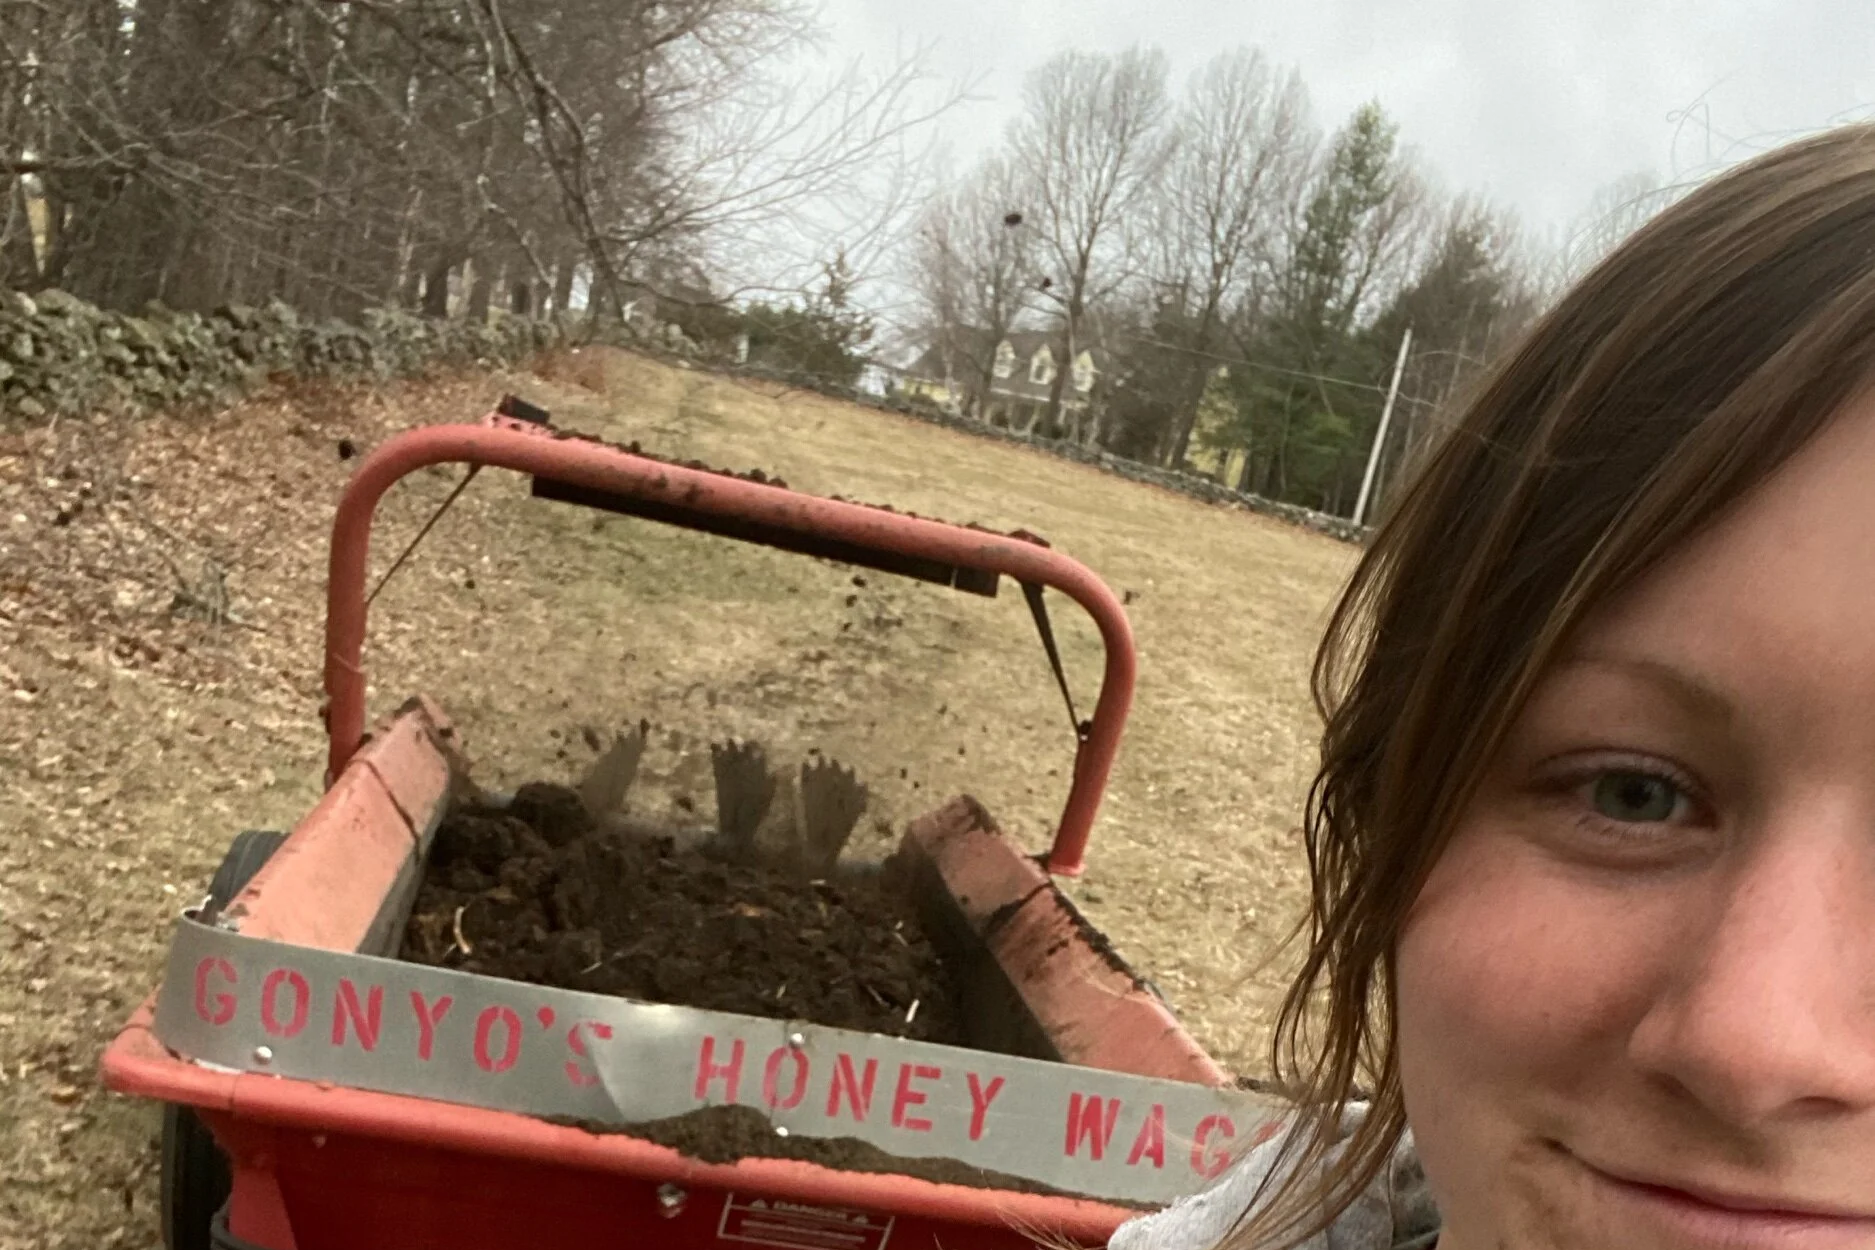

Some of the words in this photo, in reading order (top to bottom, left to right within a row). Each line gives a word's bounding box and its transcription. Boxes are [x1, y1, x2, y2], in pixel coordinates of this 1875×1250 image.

[194, 957, 614, 1087] GONYO'S
[695, 1035, 1005, 1141] HONEY
[1063, 1092, 1286, 1181] WAG
